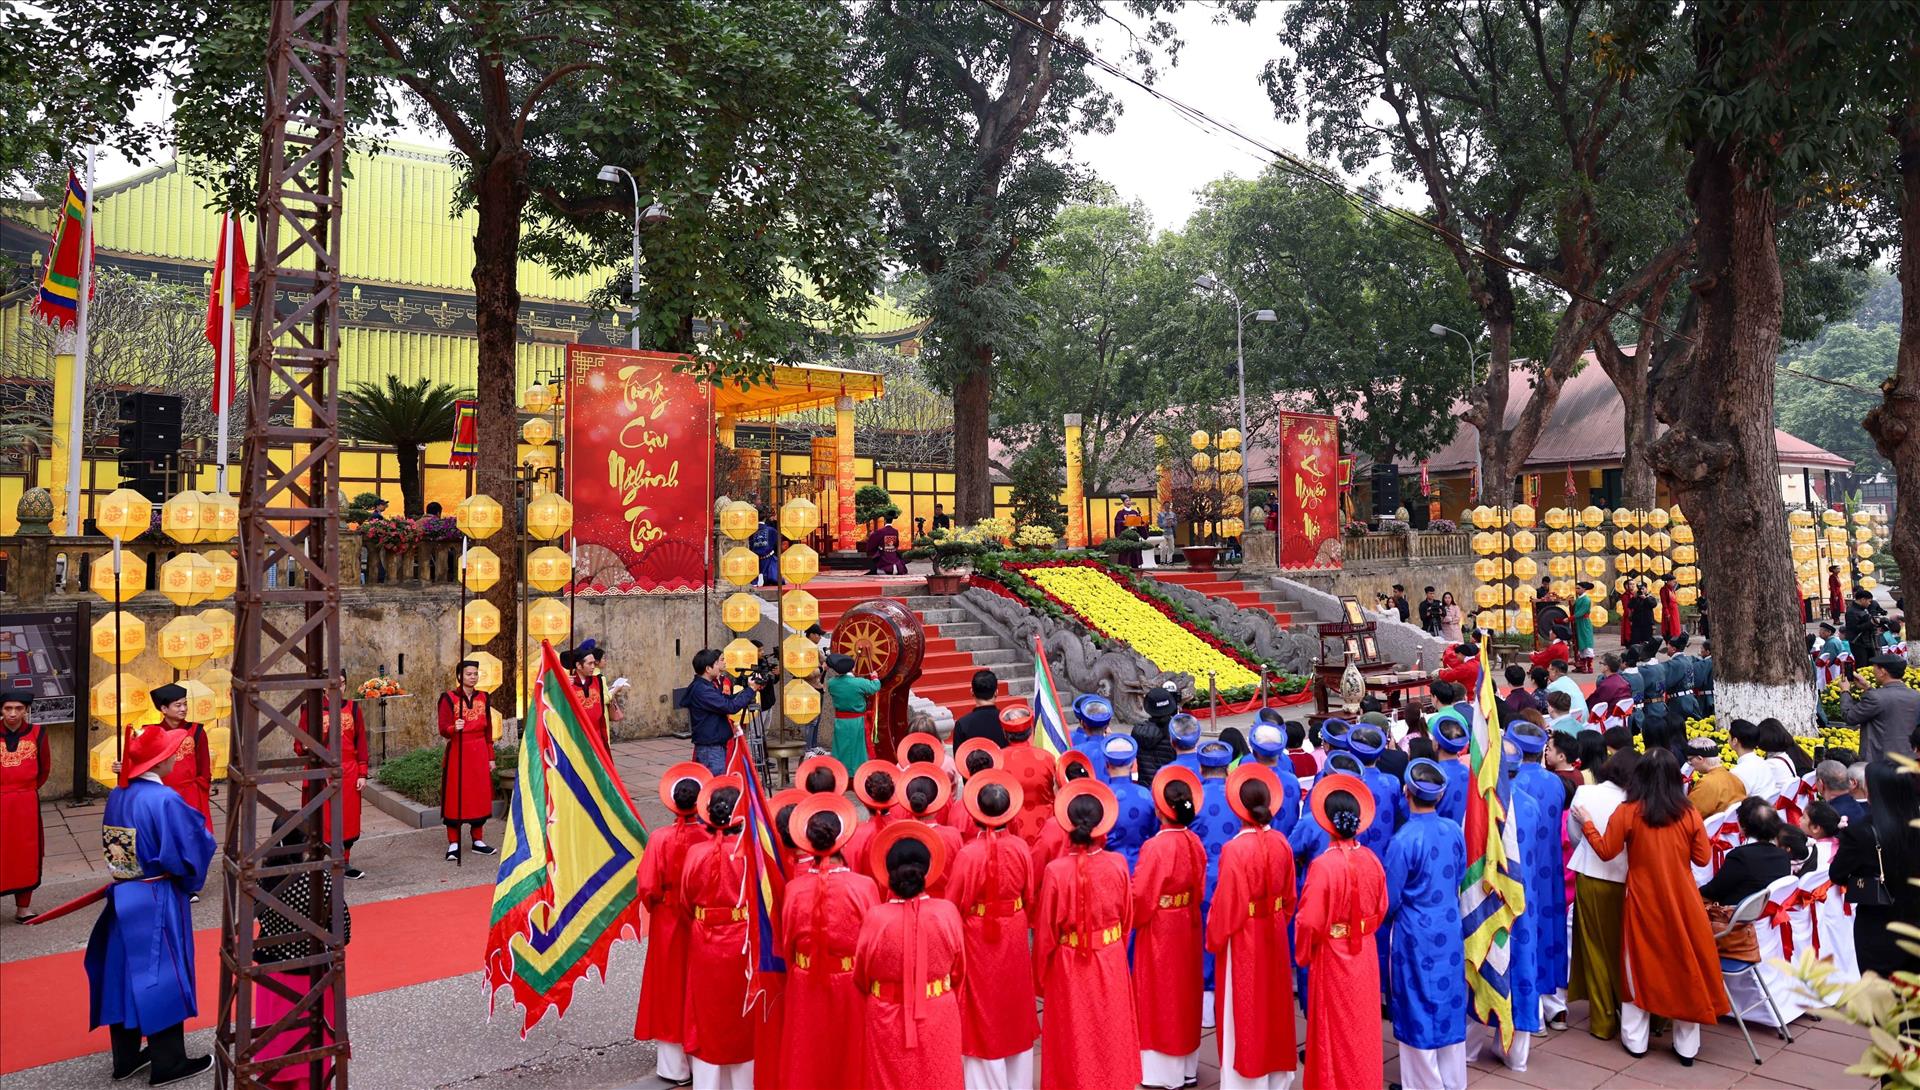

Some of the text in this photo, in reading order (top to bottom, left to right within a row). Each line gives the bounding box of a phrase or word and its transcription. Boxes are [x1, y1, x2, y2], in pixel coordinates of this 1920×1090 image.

[617, 365, 672, 420] Tống
[619, 416, 668, 453] Cựu
[608, 450, 679, 506] Nghinh
[1295, 472, 1327, 510] Nguyên
[624, 505, 664, 553] Tân
